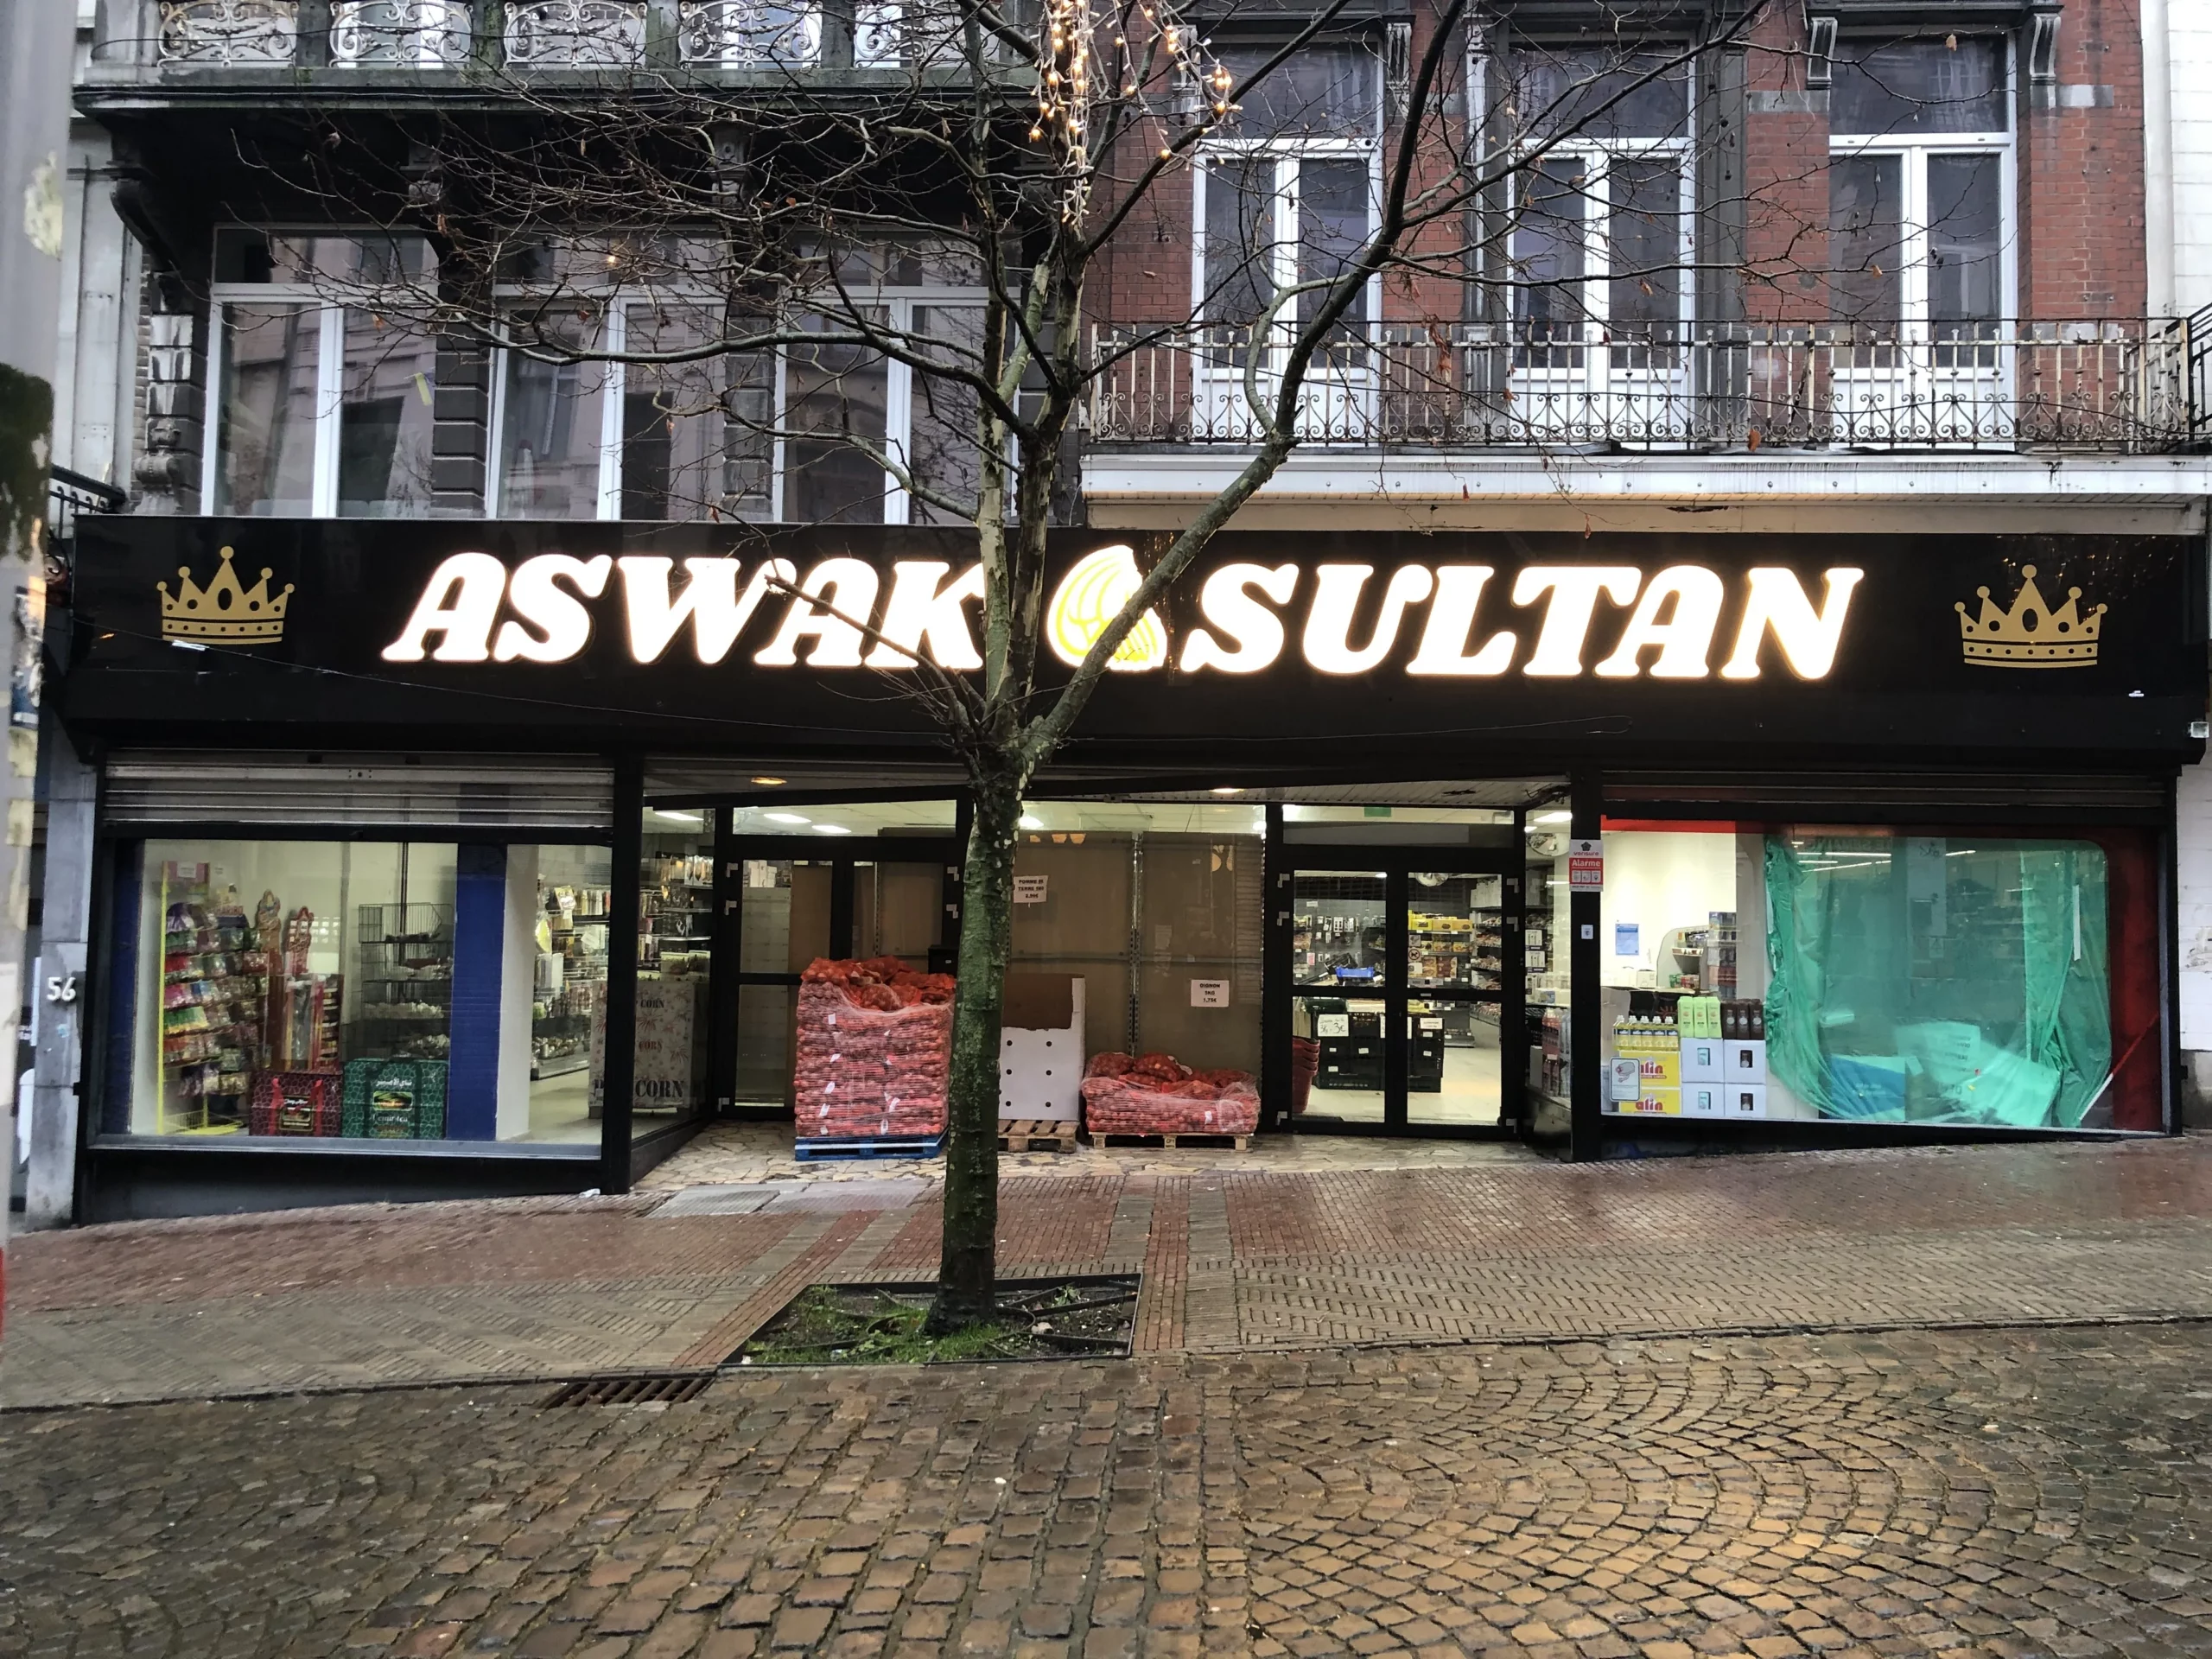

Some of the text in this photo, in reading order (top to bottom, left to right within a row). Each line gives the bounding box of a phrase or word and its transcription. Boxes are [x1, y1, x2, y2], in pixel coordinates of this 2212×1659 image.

[380, 551, 1866, 681] ASWAK SULTAN
[47, 976, 76, 1001] 56
[641, 999, 664, 1007] CORN
[635, 1080, 684, 1097] CORN
[1636, 1098, 1662, 1110] alin
